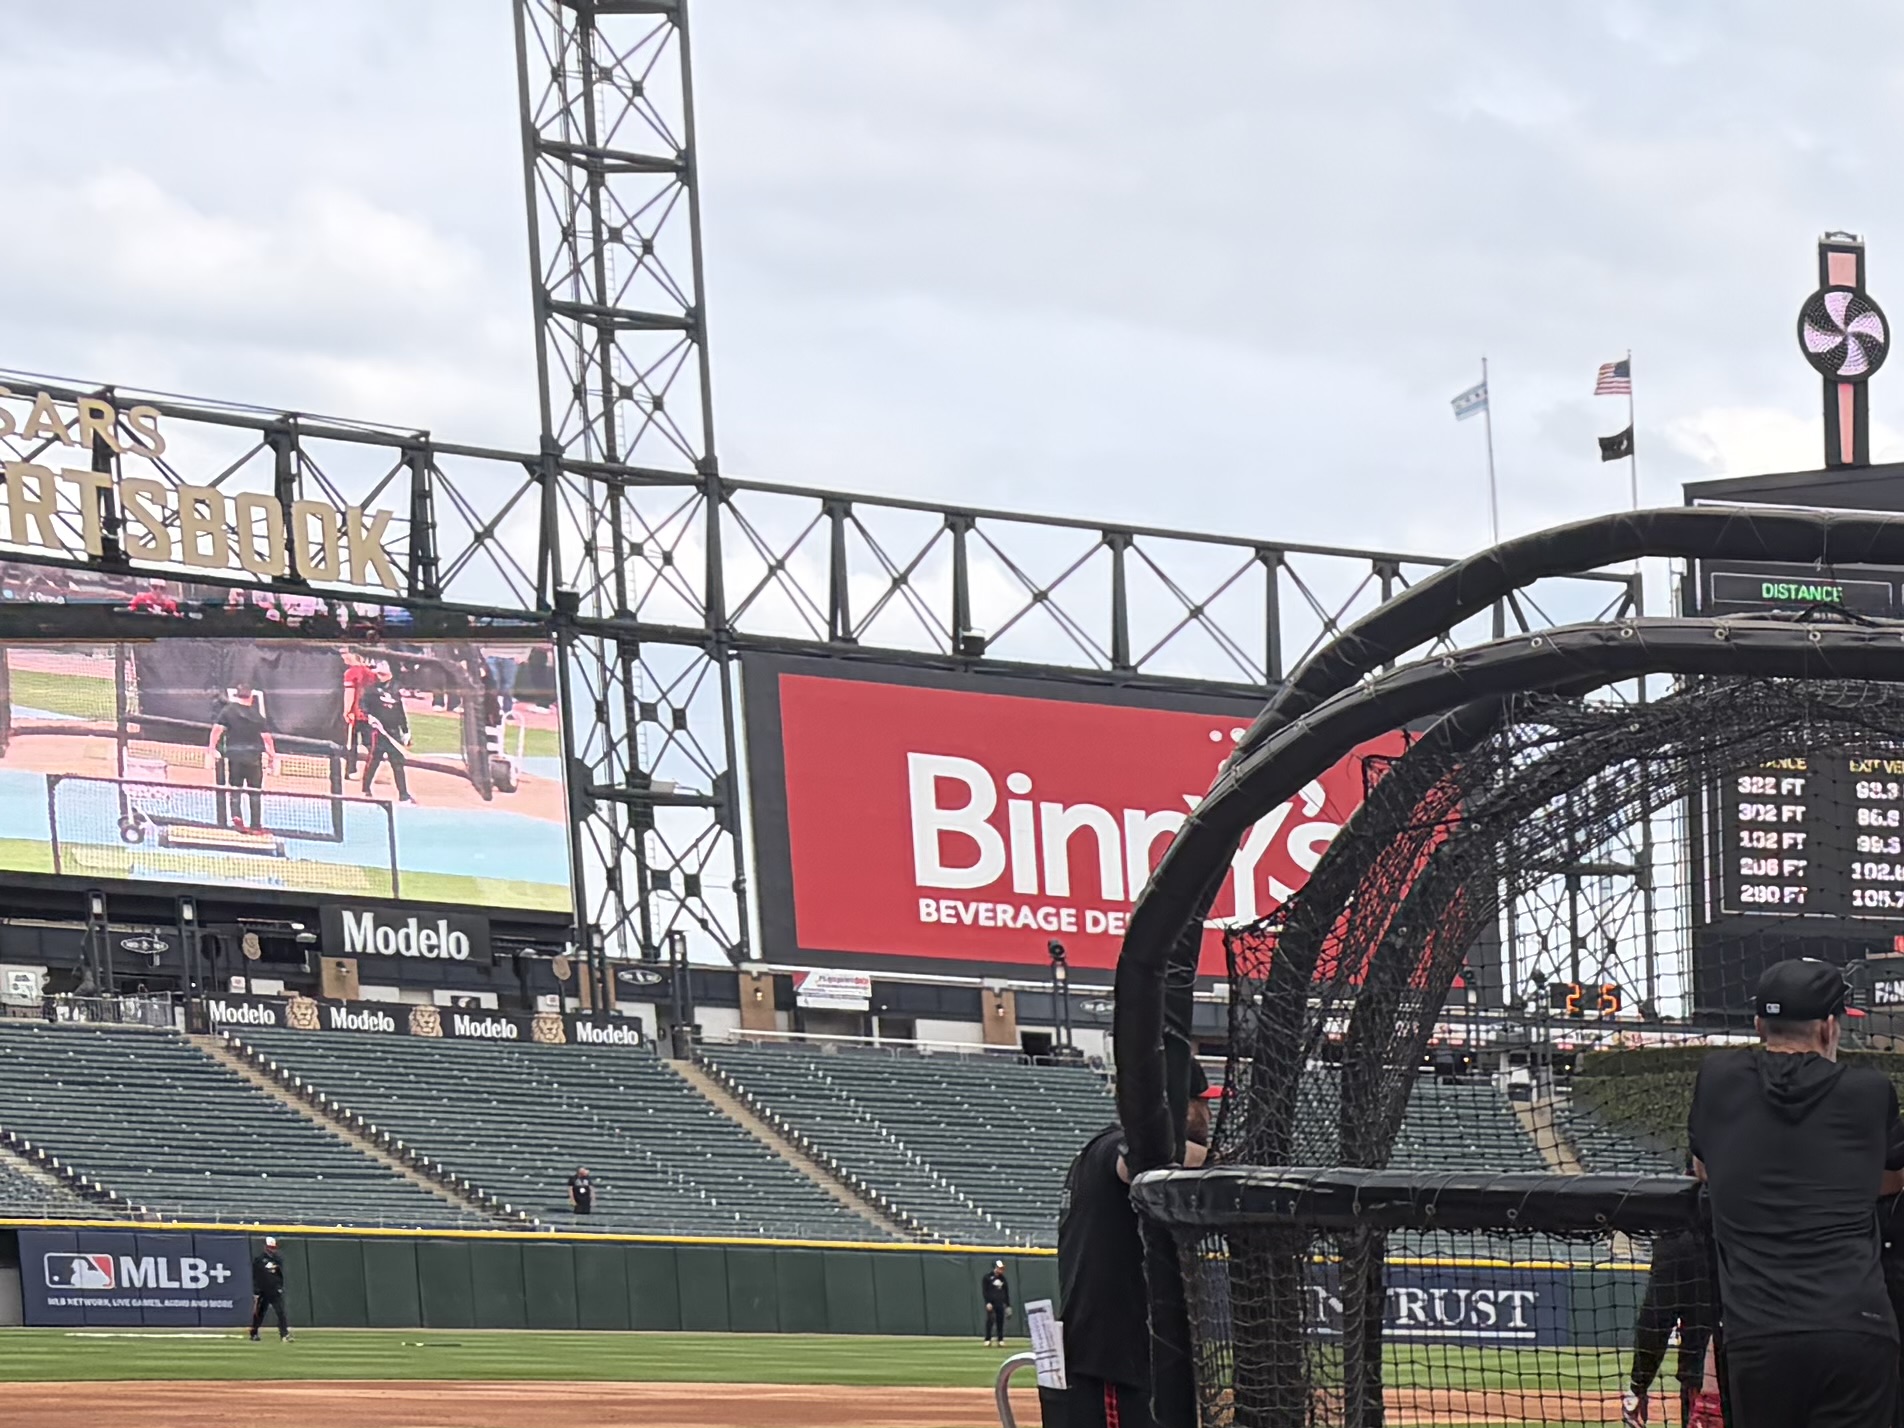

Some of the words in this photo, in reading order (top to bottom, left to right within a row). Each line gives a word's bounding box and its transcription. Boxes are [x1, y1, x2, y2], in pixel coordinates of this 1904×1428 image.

[1762, 582, 1843, 602] DISTANCE
[1781, 778, 1805, 796] FT
[1782, 805, 1806, 823] FT
[1782, 832, 1807, 851] FT
[1783, 859, 1807, 878] FT
[1784, 886, 1808, 904] FT
[919, 898, 1077, 933] BEVERAGE
[342, 910, 470, 961] Modelo
[209, 1000, 276, 1026] Modelo
[330, 1007, 395, 1032] Modelo
[454, 1014, 518, 1039] Modelo
[576, 1021, 639, 1046] Modelo
[119, 1255, 232, 1290] MLB+
